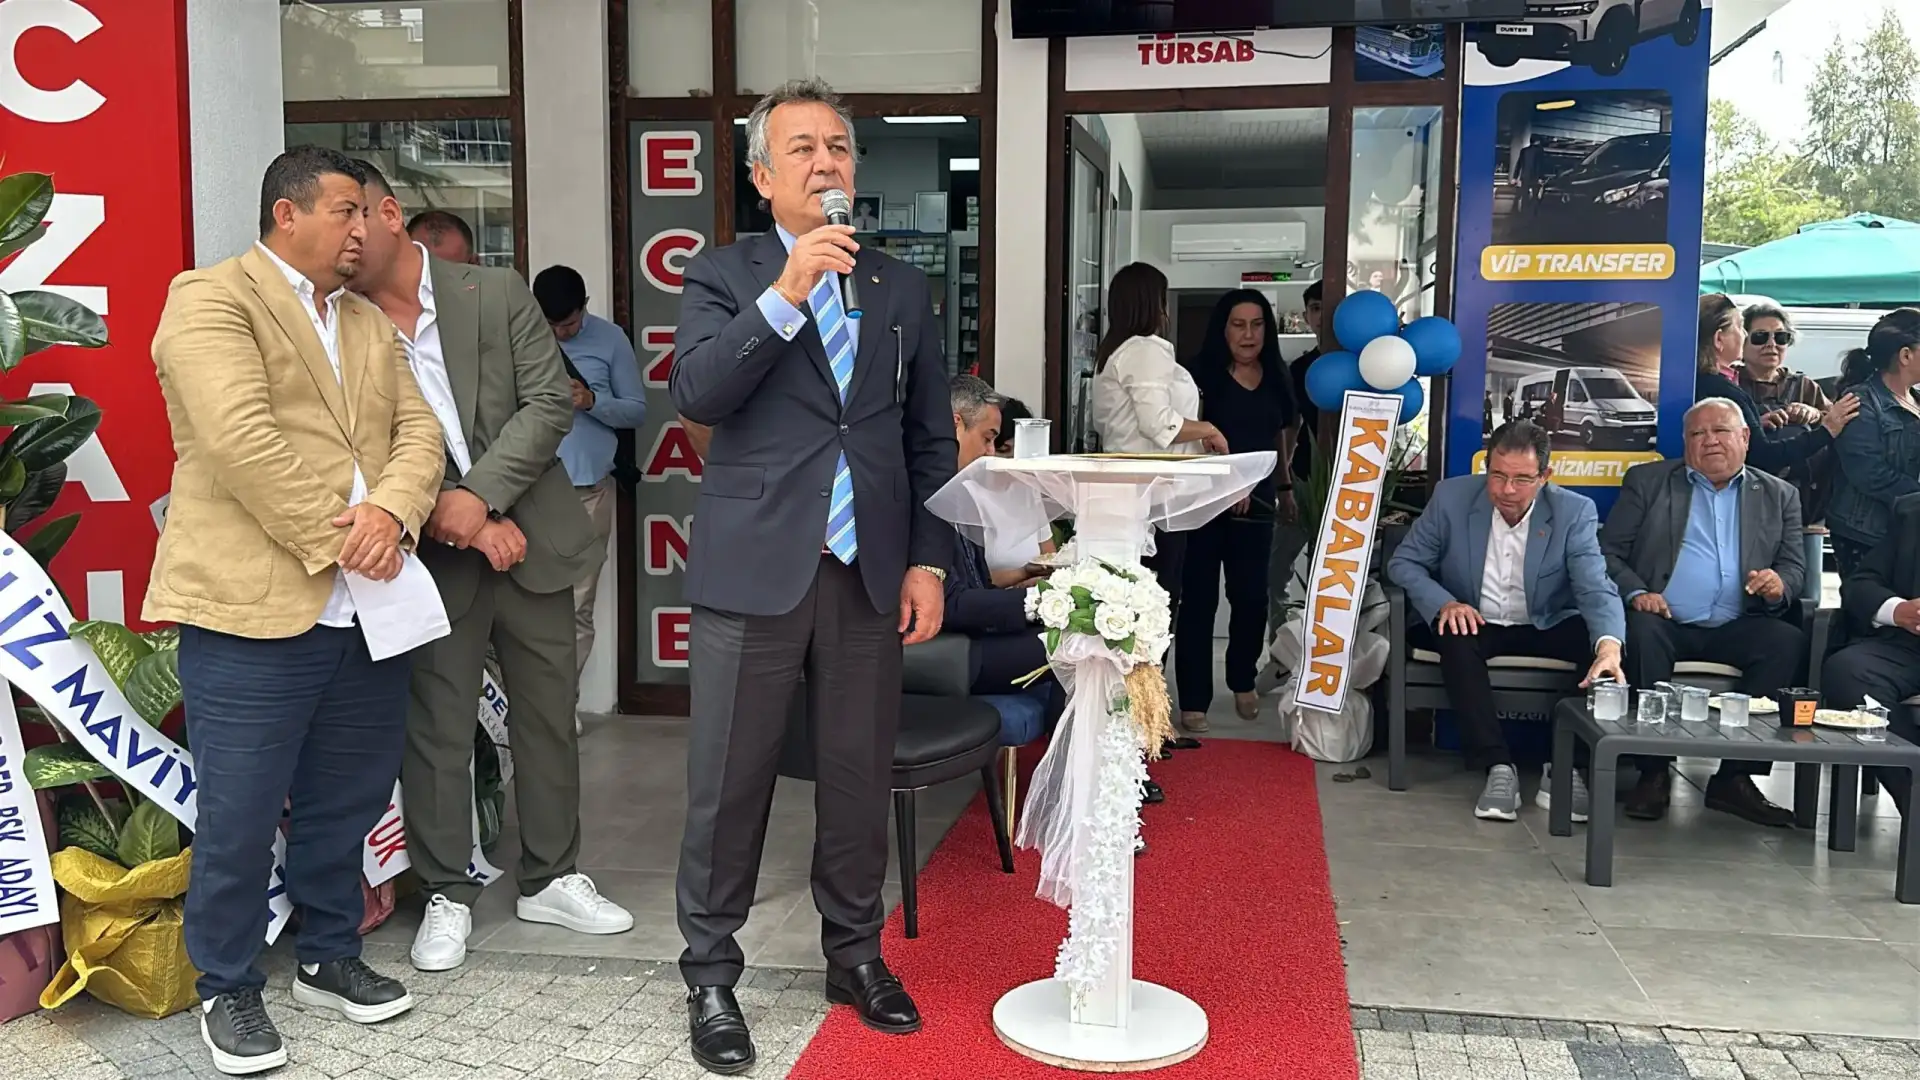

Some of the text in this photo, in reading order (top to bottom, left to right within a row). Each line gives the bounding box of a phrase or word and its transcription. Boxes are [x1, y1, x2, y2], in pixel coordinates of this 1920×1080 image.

[1138, 40, 1254, 65] TÜRSAB
[1490, 250, 1666, 273] VİP TRANSFER
[1305, 416, 1389, 698] KABAKLAR
